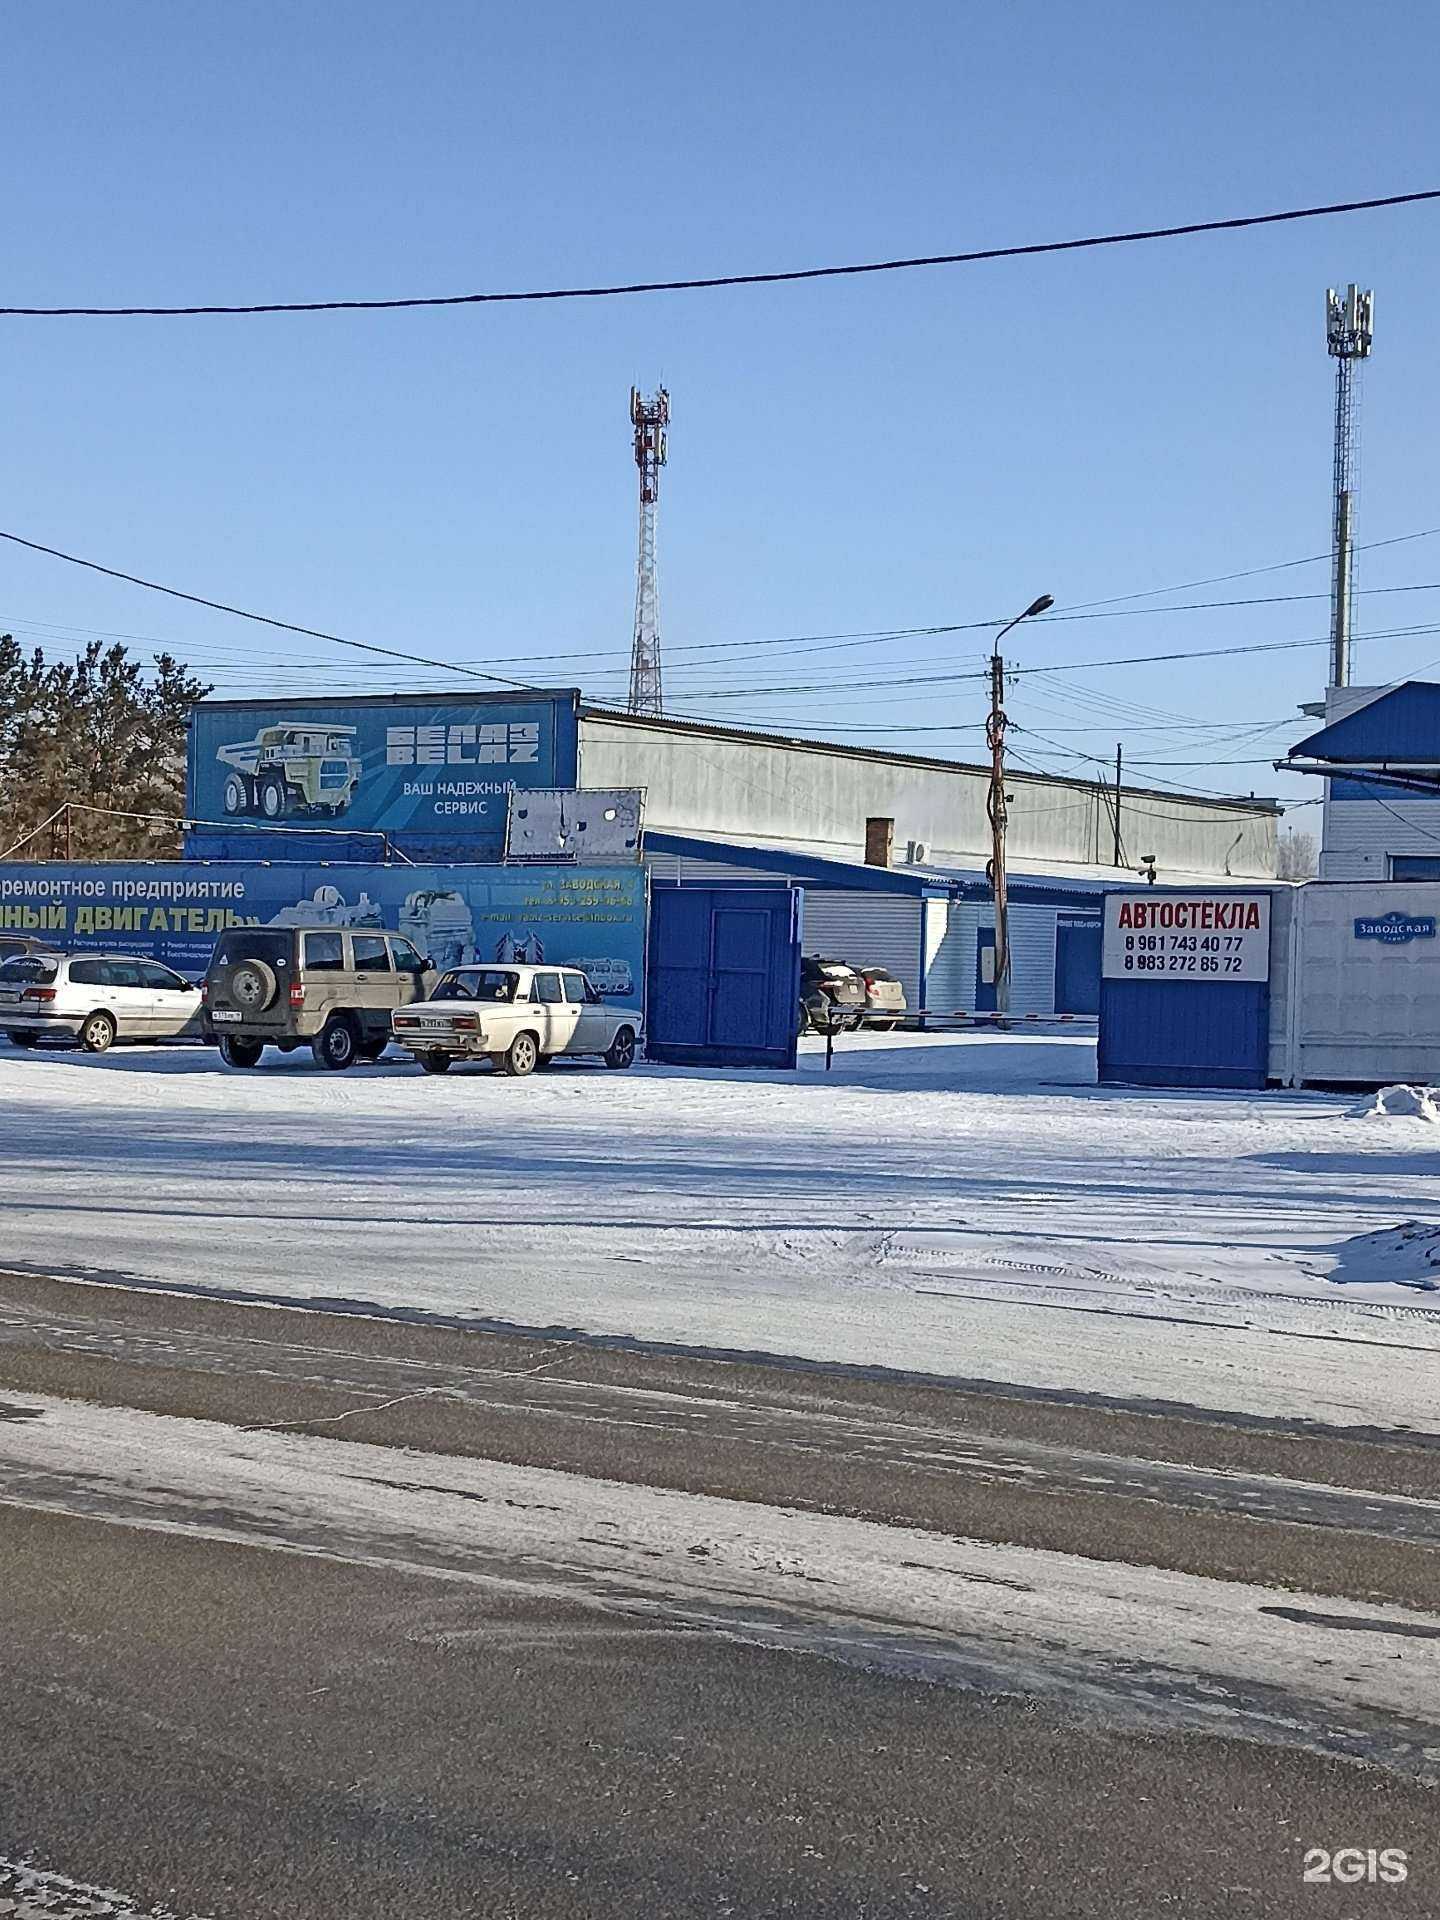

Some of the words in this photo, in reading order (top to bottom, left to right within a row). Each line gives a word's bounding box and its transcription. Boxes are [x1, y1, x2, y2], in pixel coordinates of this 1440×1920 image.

[387, 723, 539, 745] БЕЛАЗ
[387, 743, 539, 765] BELAZ
[403, 782, 433, 795] ВАШ
[434, 801, 487, 814] СЕРВИС
[0, 880, 106, 899] ремонтное
[112, 880, 245, 901] предприятие
[0, 900, 67, 929] НЫЙ
[1360, 924, 1430, 934] Заводская
[1125, 935, 1134, 950] 8
[1138, 935, 1165, 951] 961
[1170, 936, 1197, 951] 743
[1201, 937, 1220, 952] 40
[1224, 937, 1243, 951] 77
[1125, 955, 1133, 970] 8
[1137, 955, 1165, 970] 983
[1170, 956, 1196, 971] 272
[1201, 957, 1219, 972] 85
[1224, 957, 1242, 972] 72
